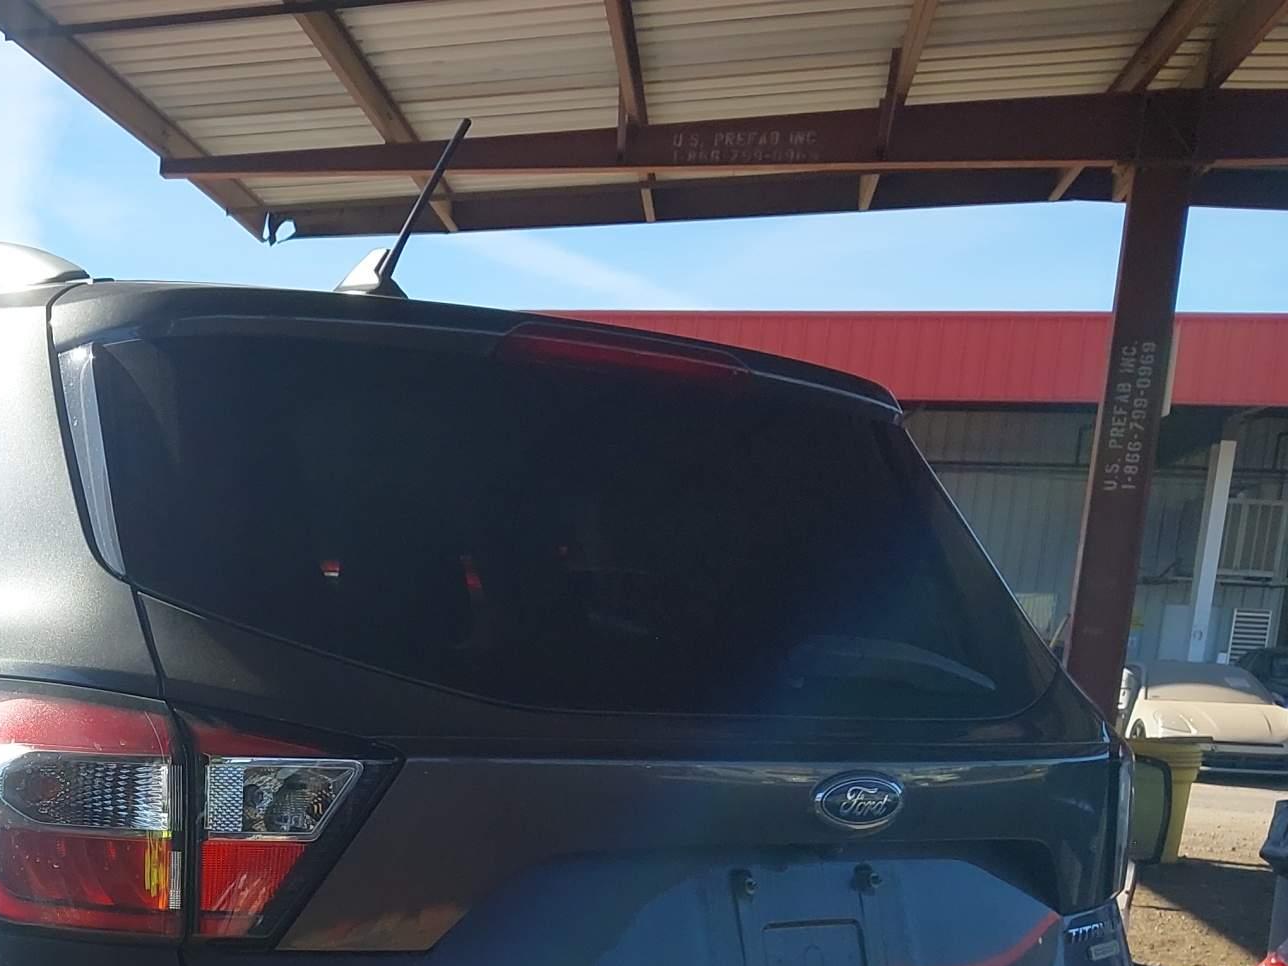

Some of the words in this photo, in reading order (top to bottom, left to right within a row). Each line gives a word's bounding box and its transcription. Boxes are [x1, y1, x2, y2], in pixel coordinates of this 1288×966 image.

[714, 130, 780, 147] PREFAB
[1119, 341, 1138, 374] INC.
[1108, 382, 1132, 450] PREFAB
[1121, 342, 1156, 490] 1-866-799-0969
[1103, 458, 1121, 491] U.S.
[839, 786, 889, 816] Ford
